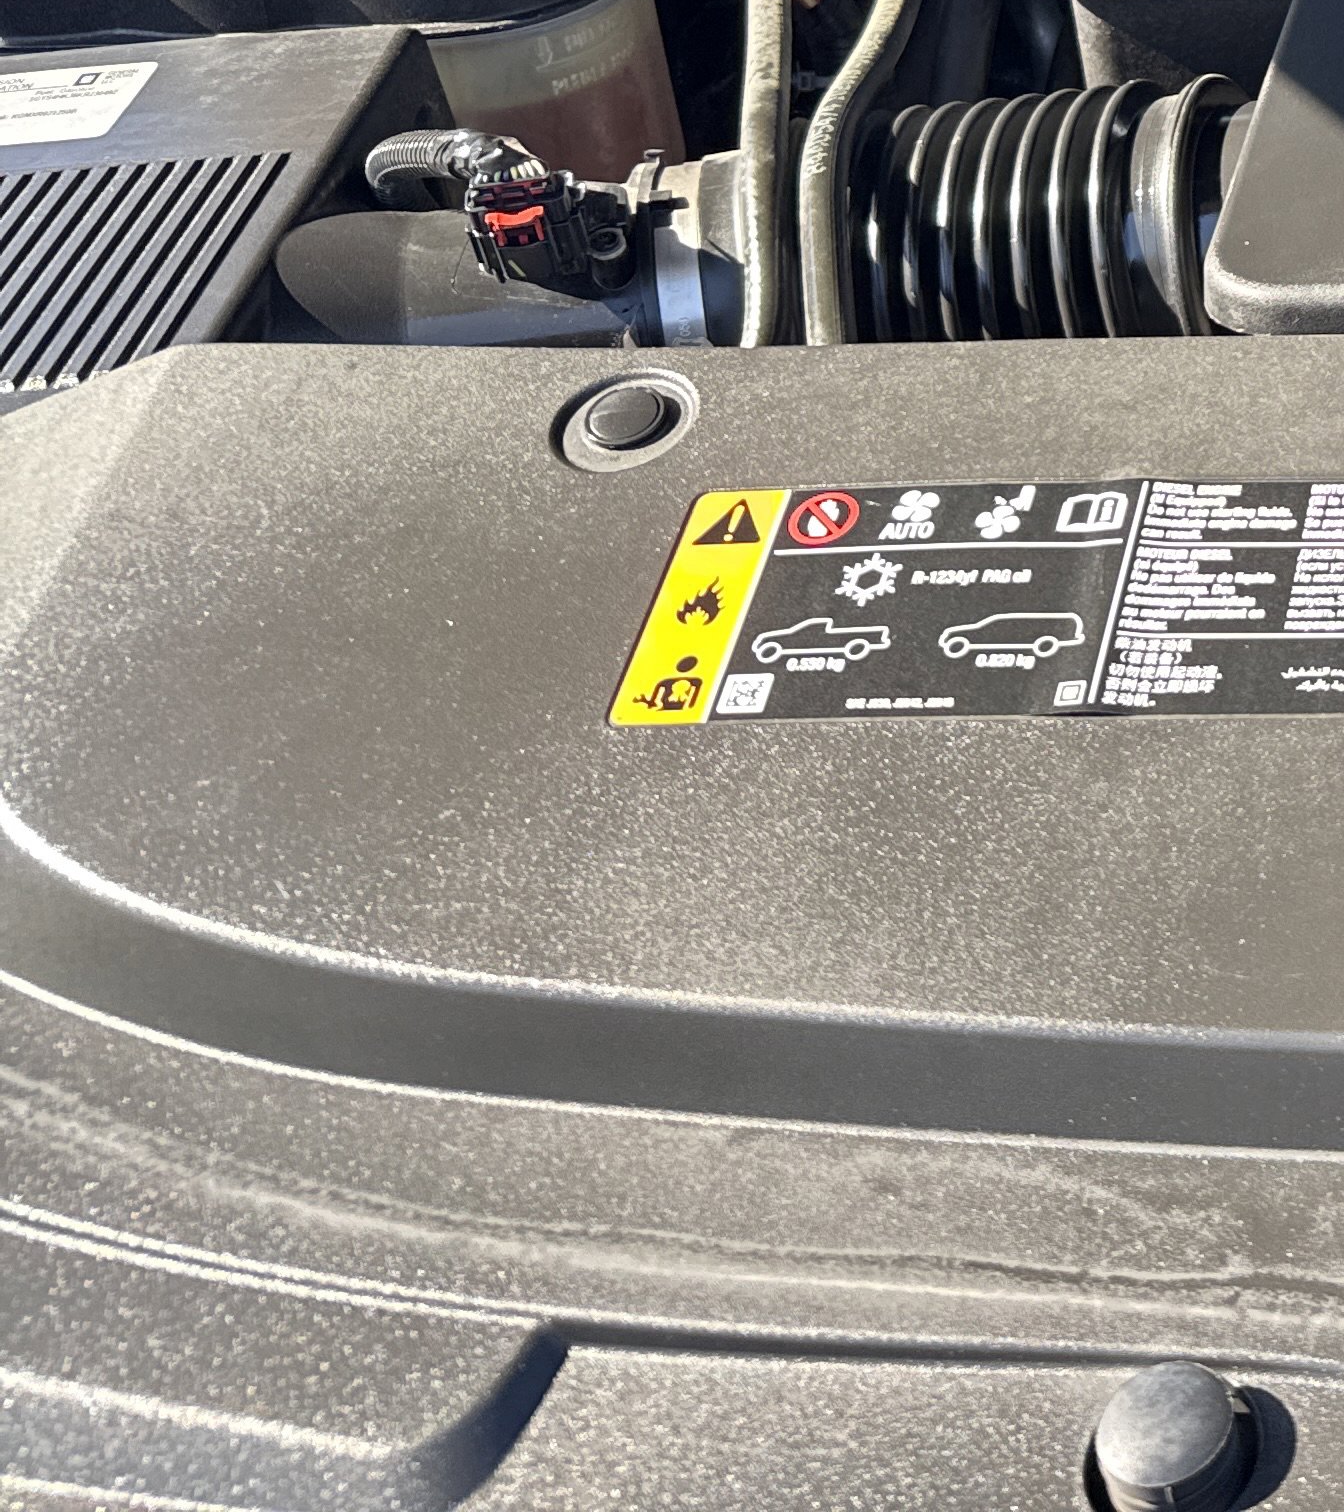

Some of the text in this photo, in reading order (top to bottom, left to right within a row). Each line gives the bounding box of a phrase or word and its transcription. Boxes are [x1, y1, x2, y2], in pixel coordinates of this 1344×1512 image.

[878, 521, 935, 540] AUTO
[827, 657, 846, 673] kg
[1015, 654, 1036, 670] kg
